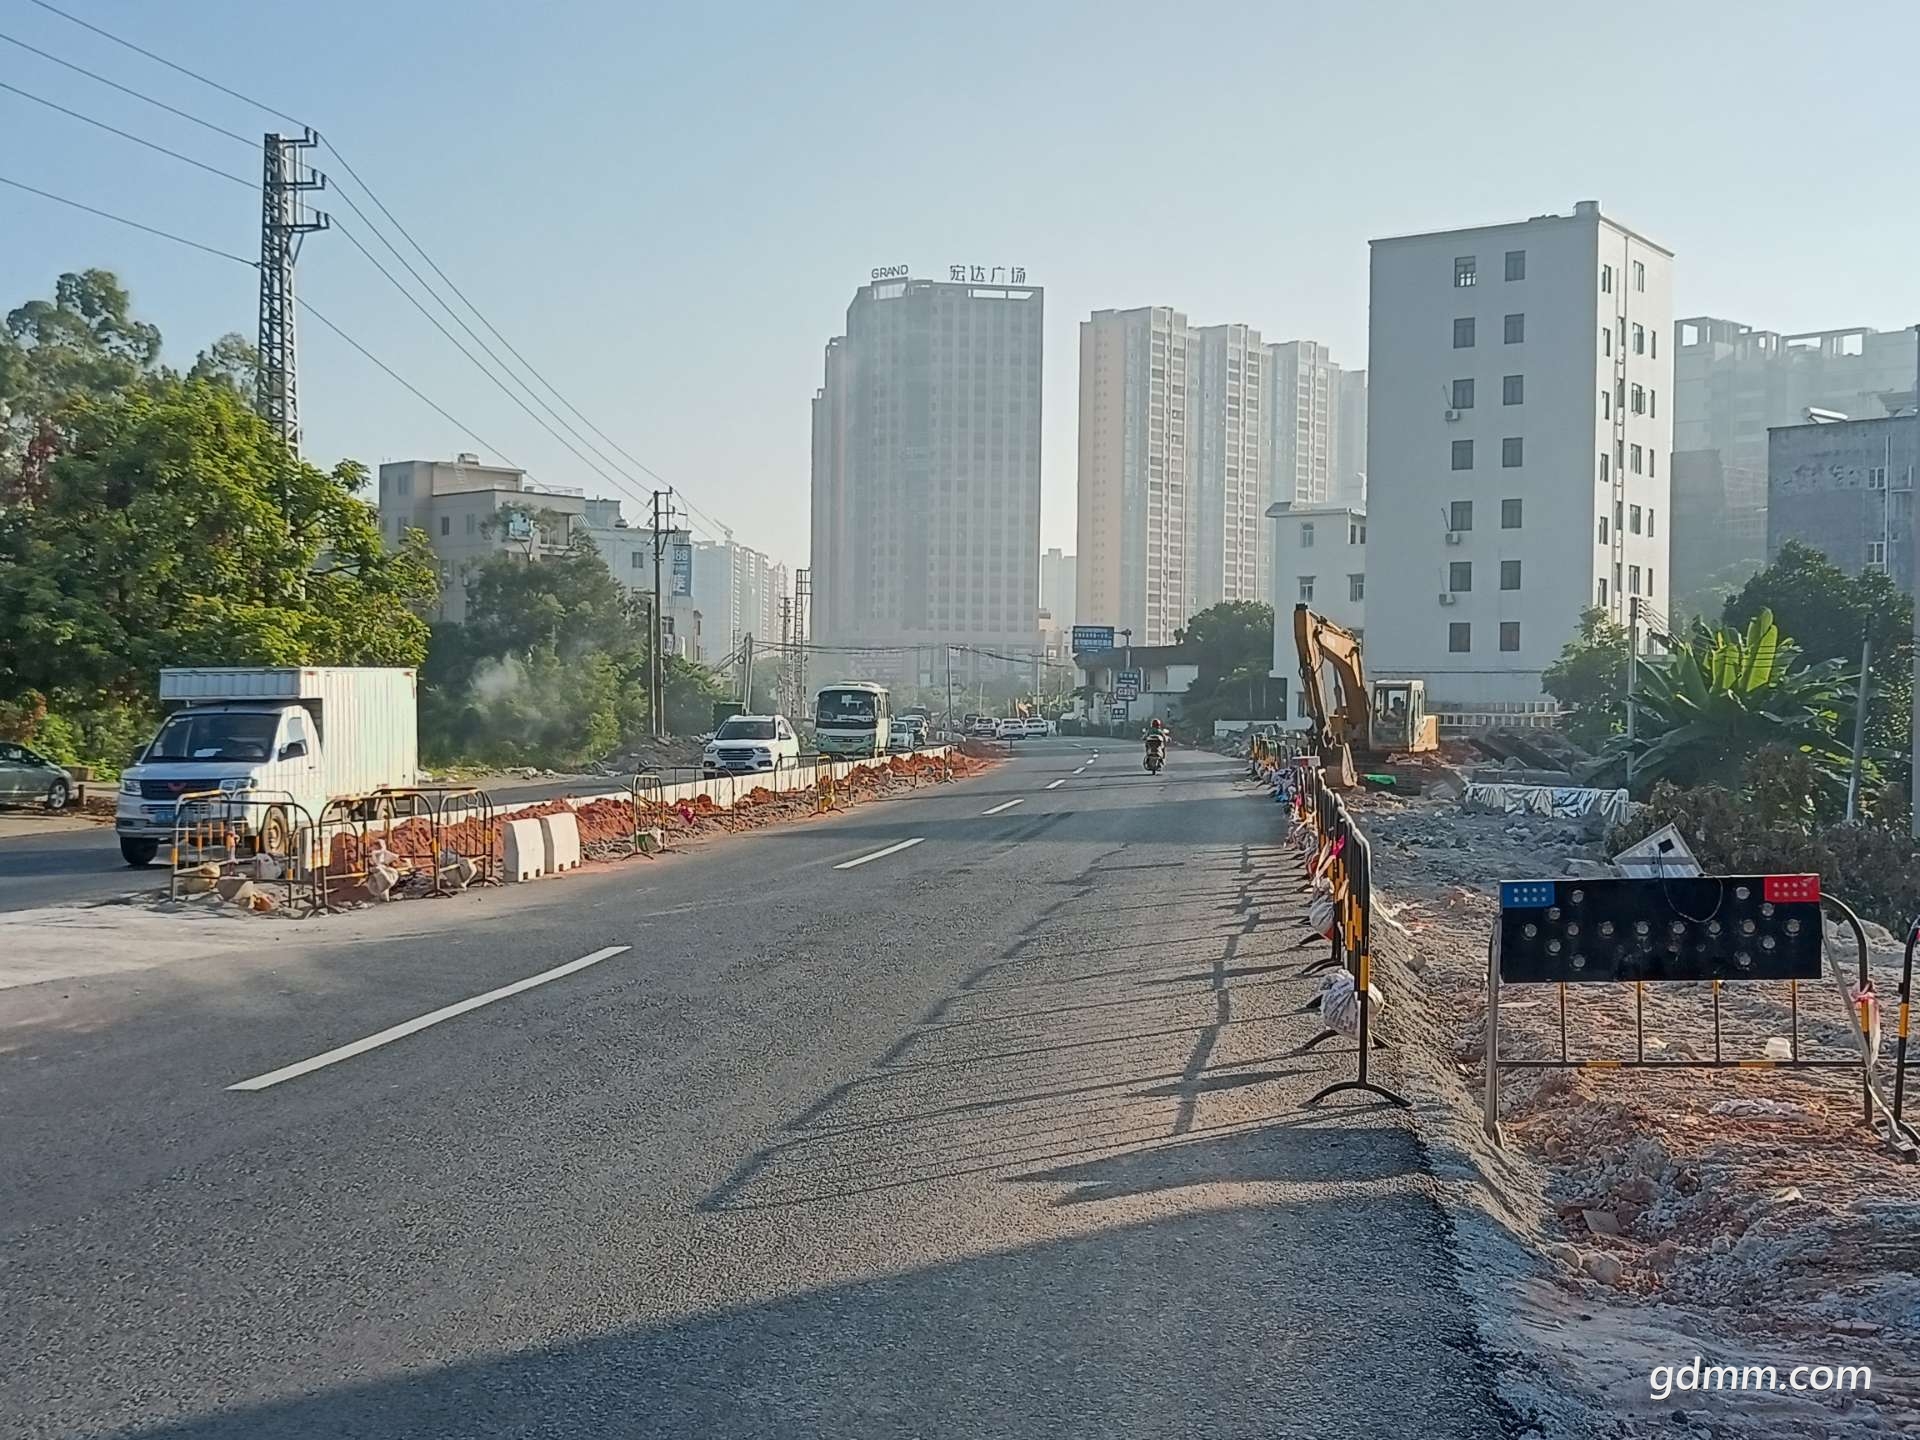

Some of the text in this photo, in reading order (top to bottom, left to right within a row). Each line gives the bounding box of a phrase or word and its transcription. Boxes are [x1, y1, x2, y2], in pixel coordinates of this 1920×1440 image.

[871, 264, 909, 280] GRAND
[950, 264, 1026, 284] 宏达广场
